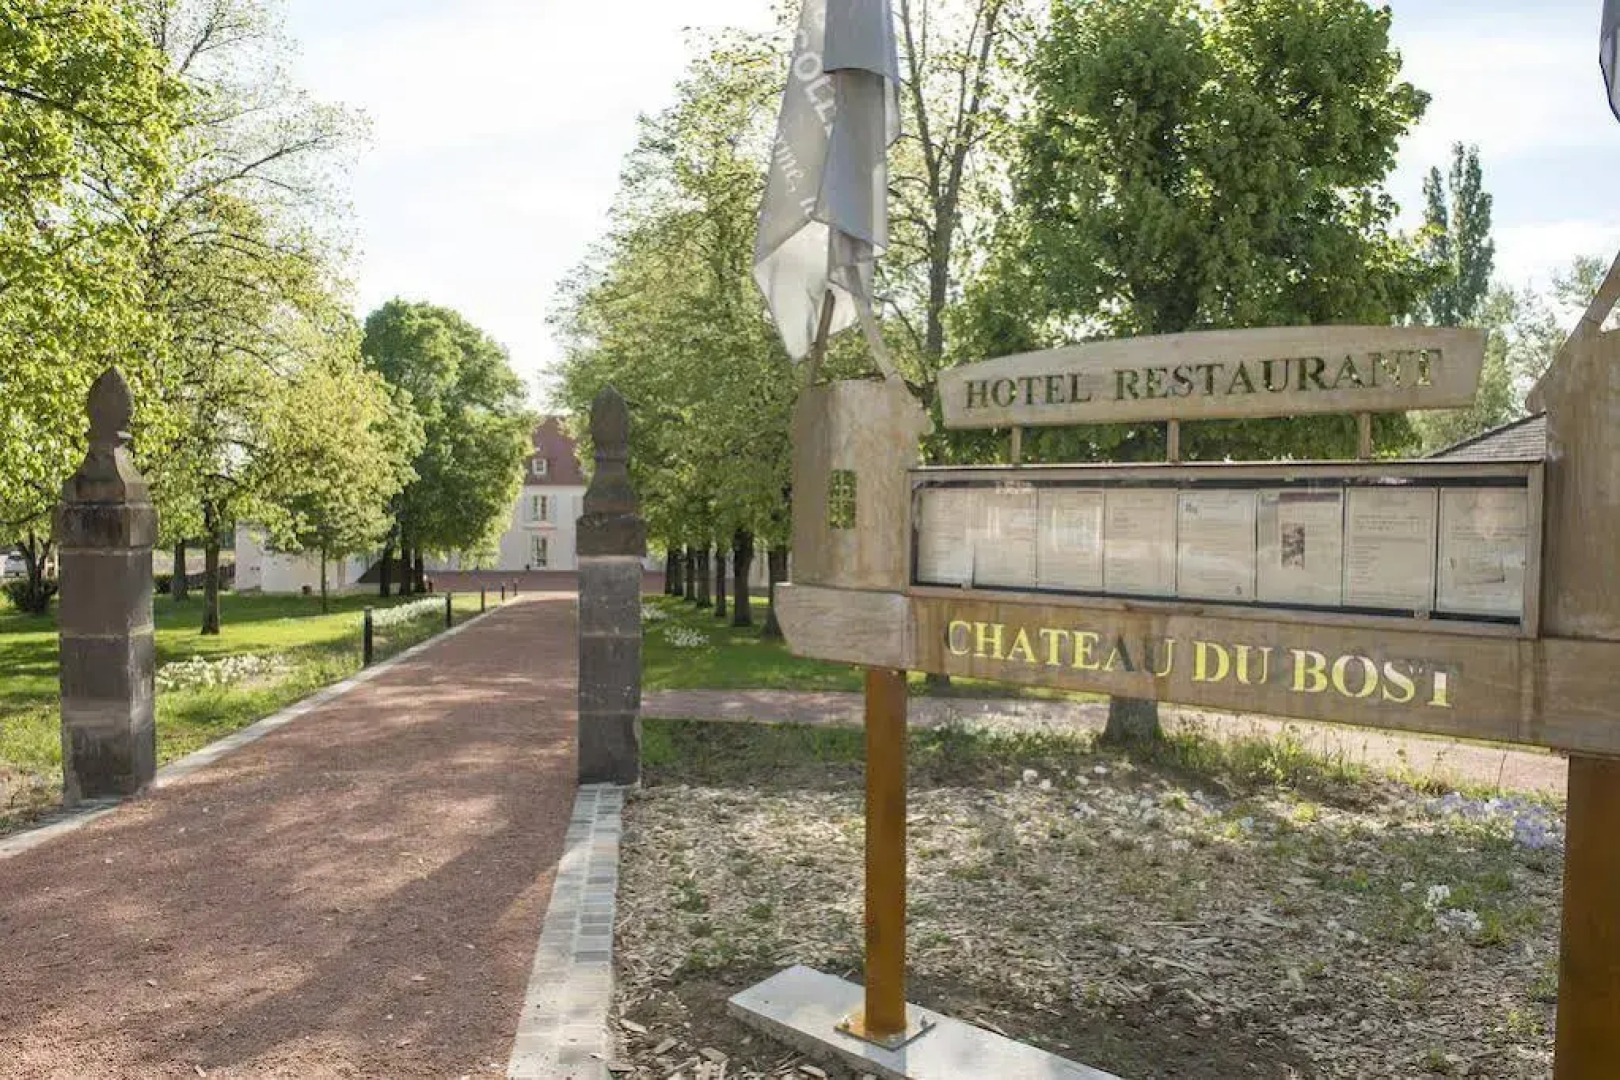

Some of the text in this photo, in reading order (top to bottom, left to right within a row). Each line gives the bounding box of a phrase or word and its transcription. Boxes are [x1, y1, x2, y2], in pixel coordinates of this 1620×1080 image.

[963, 347, 1443, 408] HOTEL RESTAURANT
[944, 620, 1463, 708] CHATEAU DU BOST
